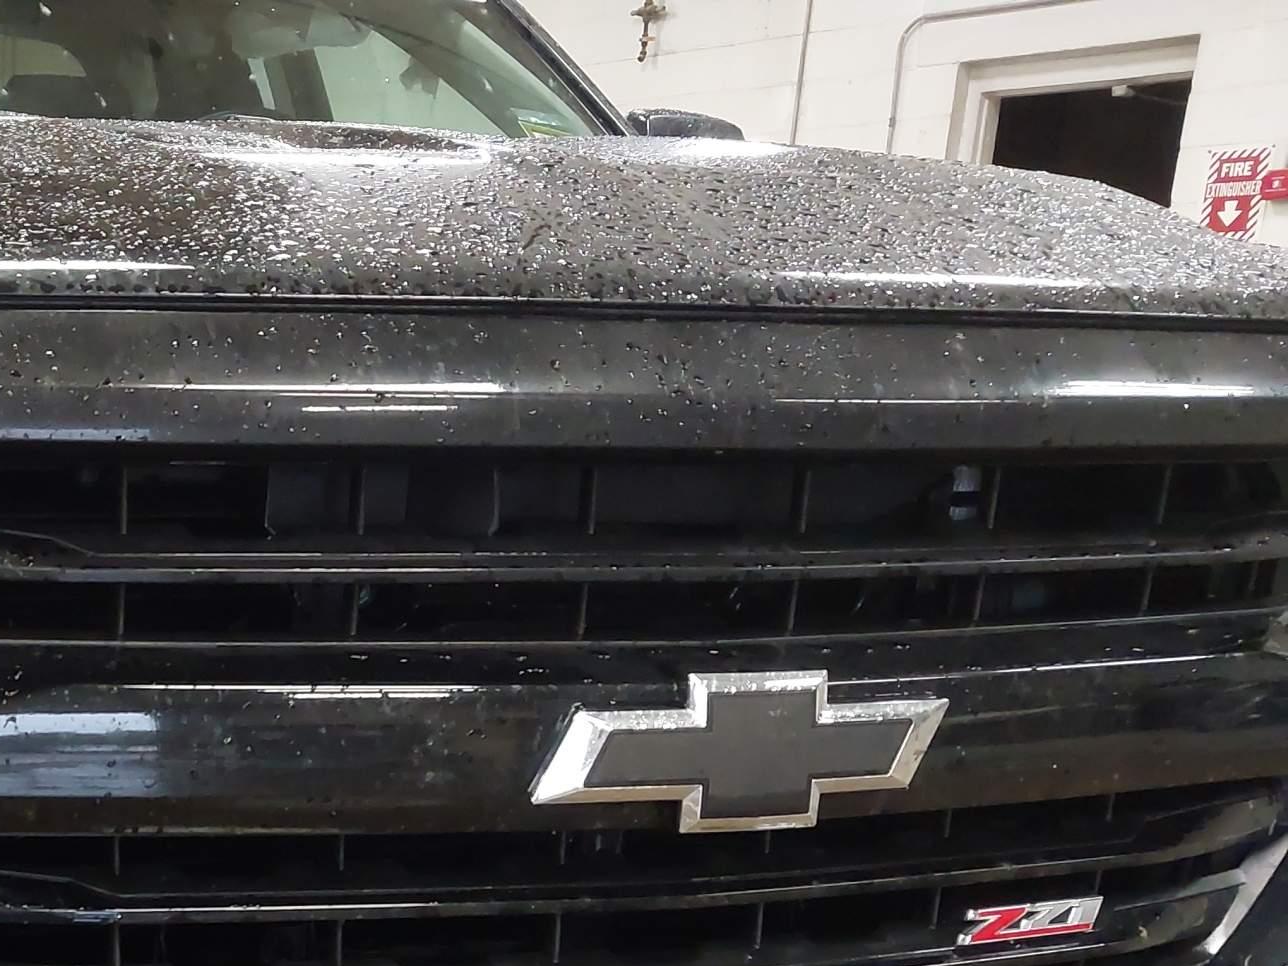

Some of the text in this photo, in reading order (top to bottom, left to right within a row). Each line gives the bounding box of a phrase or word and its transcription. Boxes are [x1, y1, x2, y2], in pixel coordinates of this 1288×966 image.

[1220, 161, 1254, 178] FIRE
[1206, 180, 1262, 198] EXTINGUISHER
[957, 896, 1103, 945] Z71
